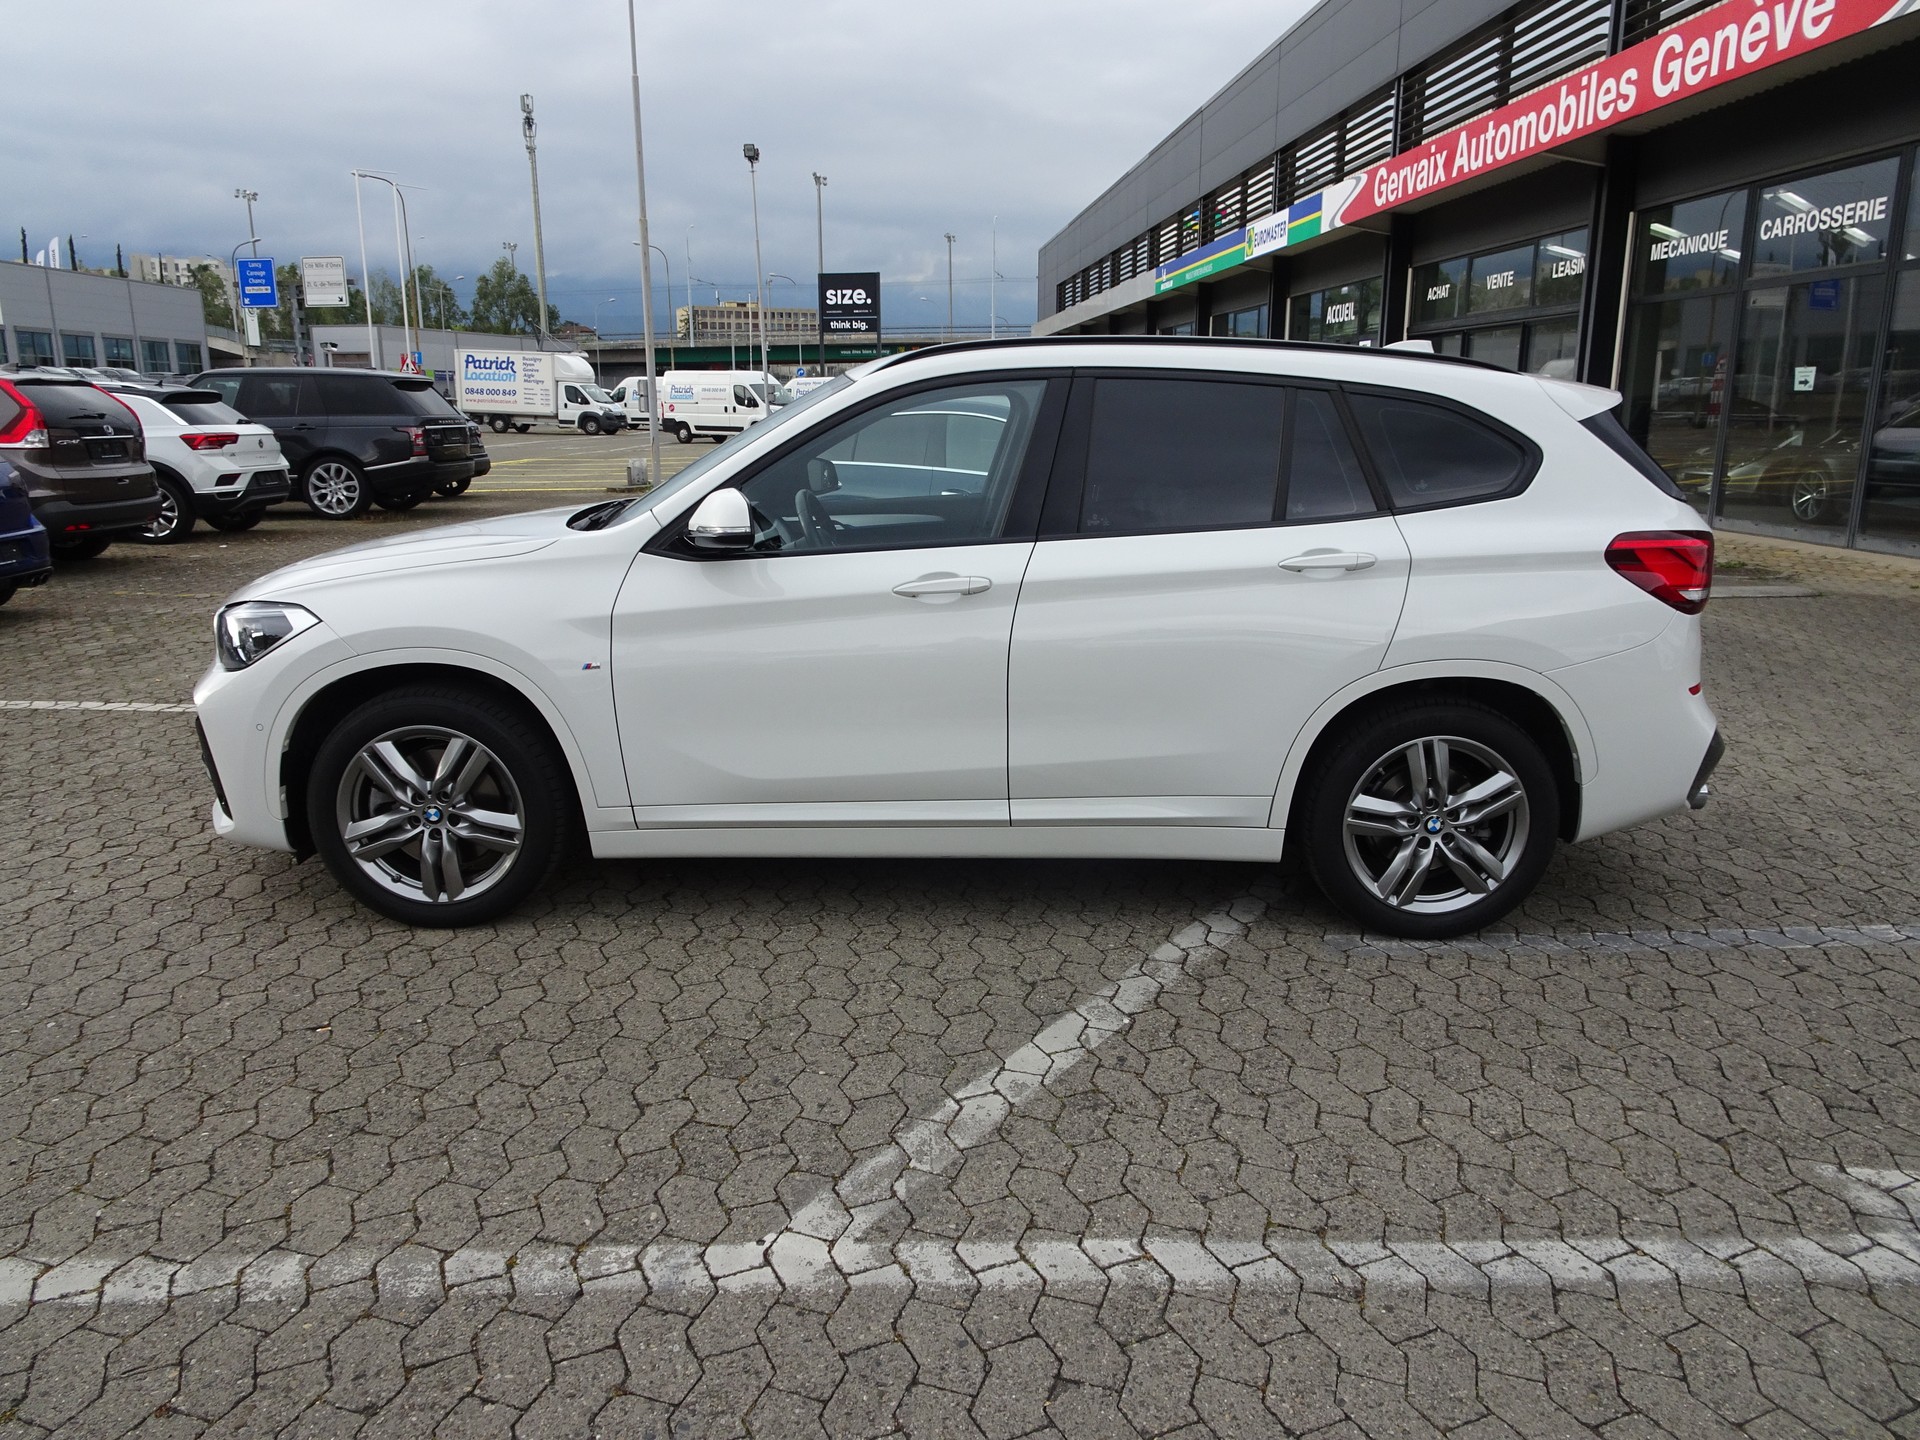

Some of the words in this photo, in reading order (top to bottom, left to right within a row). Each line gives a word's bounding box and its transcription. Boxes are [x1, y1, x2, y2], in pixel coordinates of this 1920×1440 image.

[1374, 150, 1447, 207] Gervaix
[1452, 66, 1638, 179] Automobiles
[1652, 0, 1835, 98] Genève
[1760, 197, 1888, 240] CARROSSERIE
[1254, 220, 1287, 248] EUROMASTER
[1650, 229, 1728, 261] MECANIQUE
[248, 261, 262, 269] Lancy
[1552, 257, 1586, 279] LEASIN
[1486, 270, 1514, 290] VENTE
[825, 288, 872, 305] size.
[1427, 284, 1450, 302] ACHAT
[1326, 302, 1355, 324] ACCUEIL
[830, 320, 851, 329] think
[852, 320, 868, 330] big.
[464, 354, 517, 374] Patrick
[464, 369, 516, 382] Location
[464, 387, 485, 396] 0848
[485, 387, 501, 396] 000
[501, 388, 517, 397] 849
[670, 385, 694, 395] Patrick
